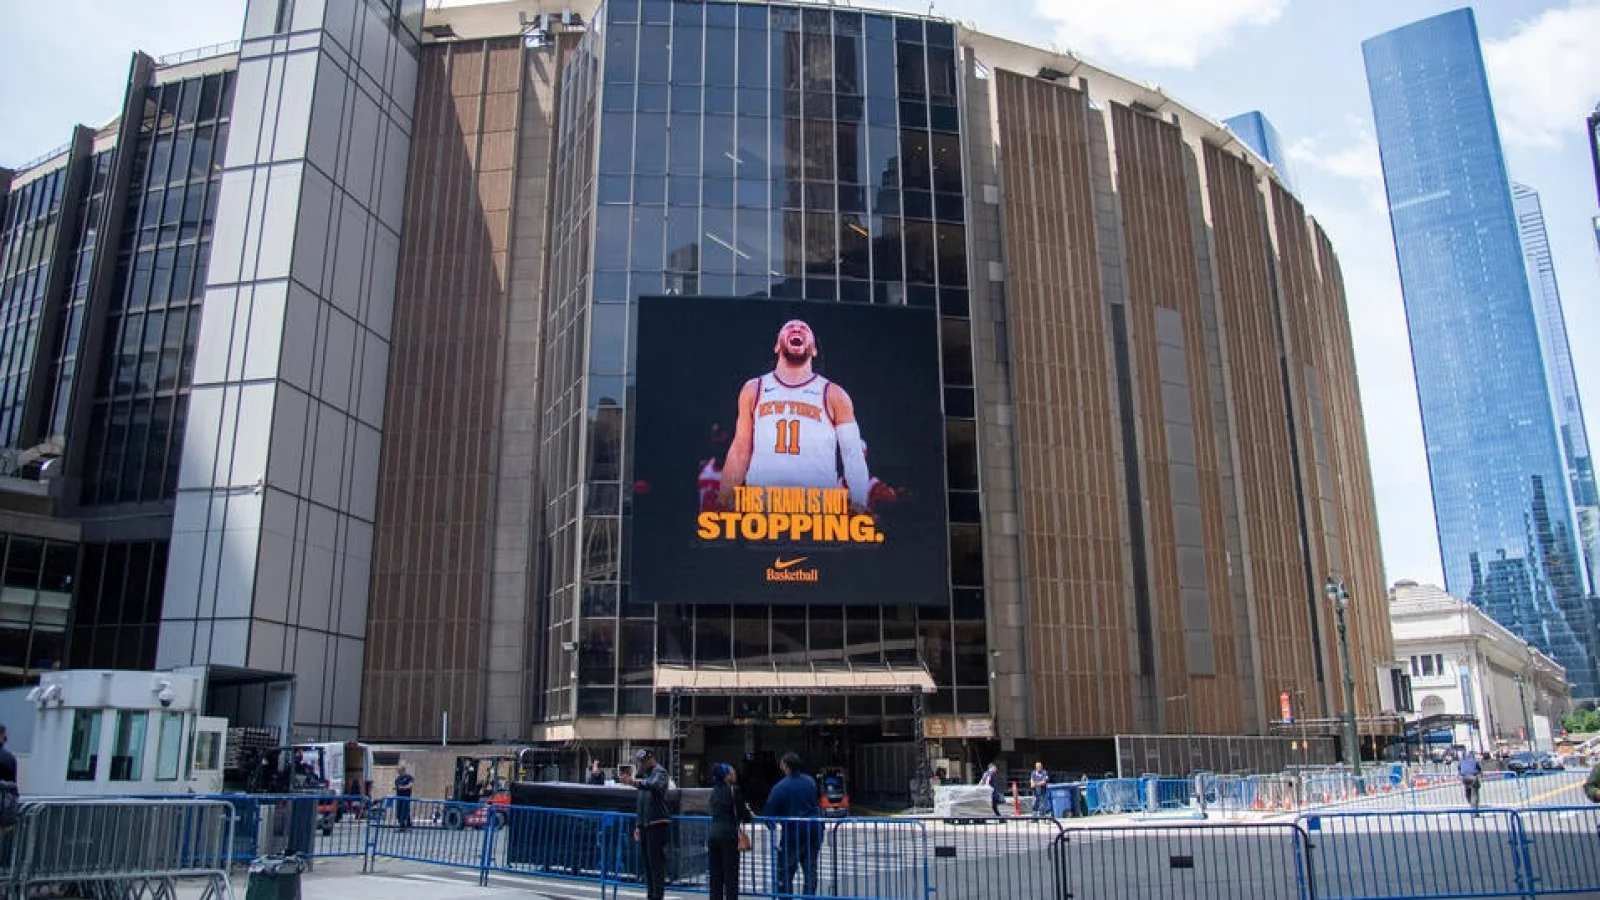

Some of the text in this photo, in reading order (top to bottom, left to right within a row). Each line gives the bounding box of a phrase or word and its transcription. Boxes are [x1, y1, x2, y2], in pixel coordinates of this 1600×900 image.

[759, 400, 822, 423] NEW YORK
[775, 419, 801, 455] 11
[733, 486, 849, 514] THIS TRAIN IS NOT
[697, 511, 885, 543] STOPPING.
[766, 568, 819, 582] Basketball
